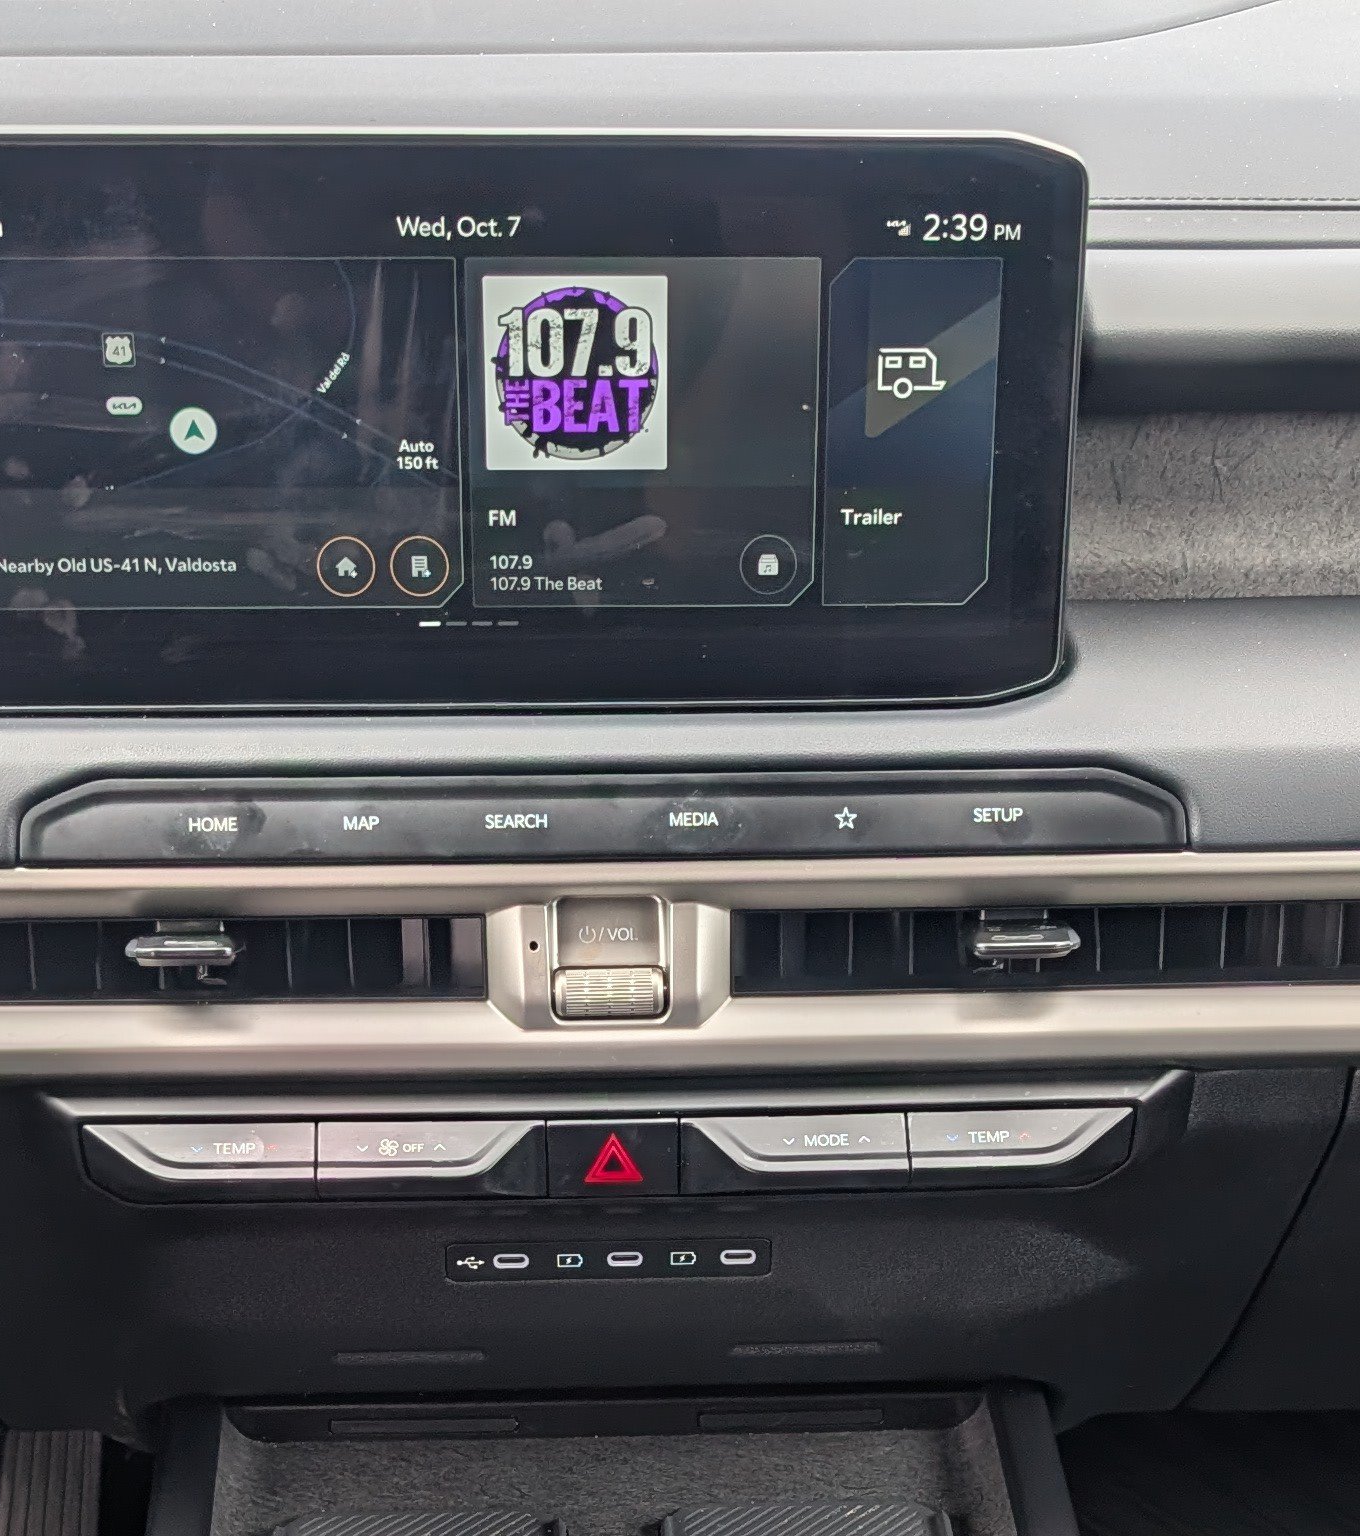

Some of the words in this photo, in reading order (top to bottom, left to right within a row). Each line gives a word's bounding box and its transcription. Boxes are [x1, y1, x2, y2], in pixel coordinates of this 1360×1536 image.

[396, 214, 452, 242] Wed,
[456, 215, 503, 238] Oct.
[506, 215, 522, 238] 7
[922, 212, 988, 242] 2:39
[993, 223, 1022, 241] PM
[498, 306, 653, 378] 107.9
[112, 345, 127, 357] 41
[504, 378, 530, 426] THE
[531, 378, 650, 434] BEAT
[399, 438, 436, 454] Auto
[396, 455, 424, 471] 150
[424, 455, 440, 471] ft
[488, 508, 518, 527] FM
[840, 507, 903, 527] Trailer
[57, 556, 87, 574] Old
[89, 557, 141, 574] US-41
[143, 557, 163, 576] N,
[164, 556, 238, 574] Valdosta
[489, 554, 534, 570] 107.9
[490, 575, 532, 591] 107.9
[533, 575, 565, 591] The
[566, 575, 604, 591] Beat
[188, 816, 239, 833] HOME
[342, 815, 380, 831] MAP
[484, 813, 549, 830] SEARCH
[669, 811, 720, 828] MEDIA
[973, 807, 1024, 823] SETUP
[803, 1133, 850, 1147] MODE
[968, 1130, 1010, 1144] TEMP
[212, 1142, 257, 1156] TEMP
[402, 1142, 425, 1154] OFF
